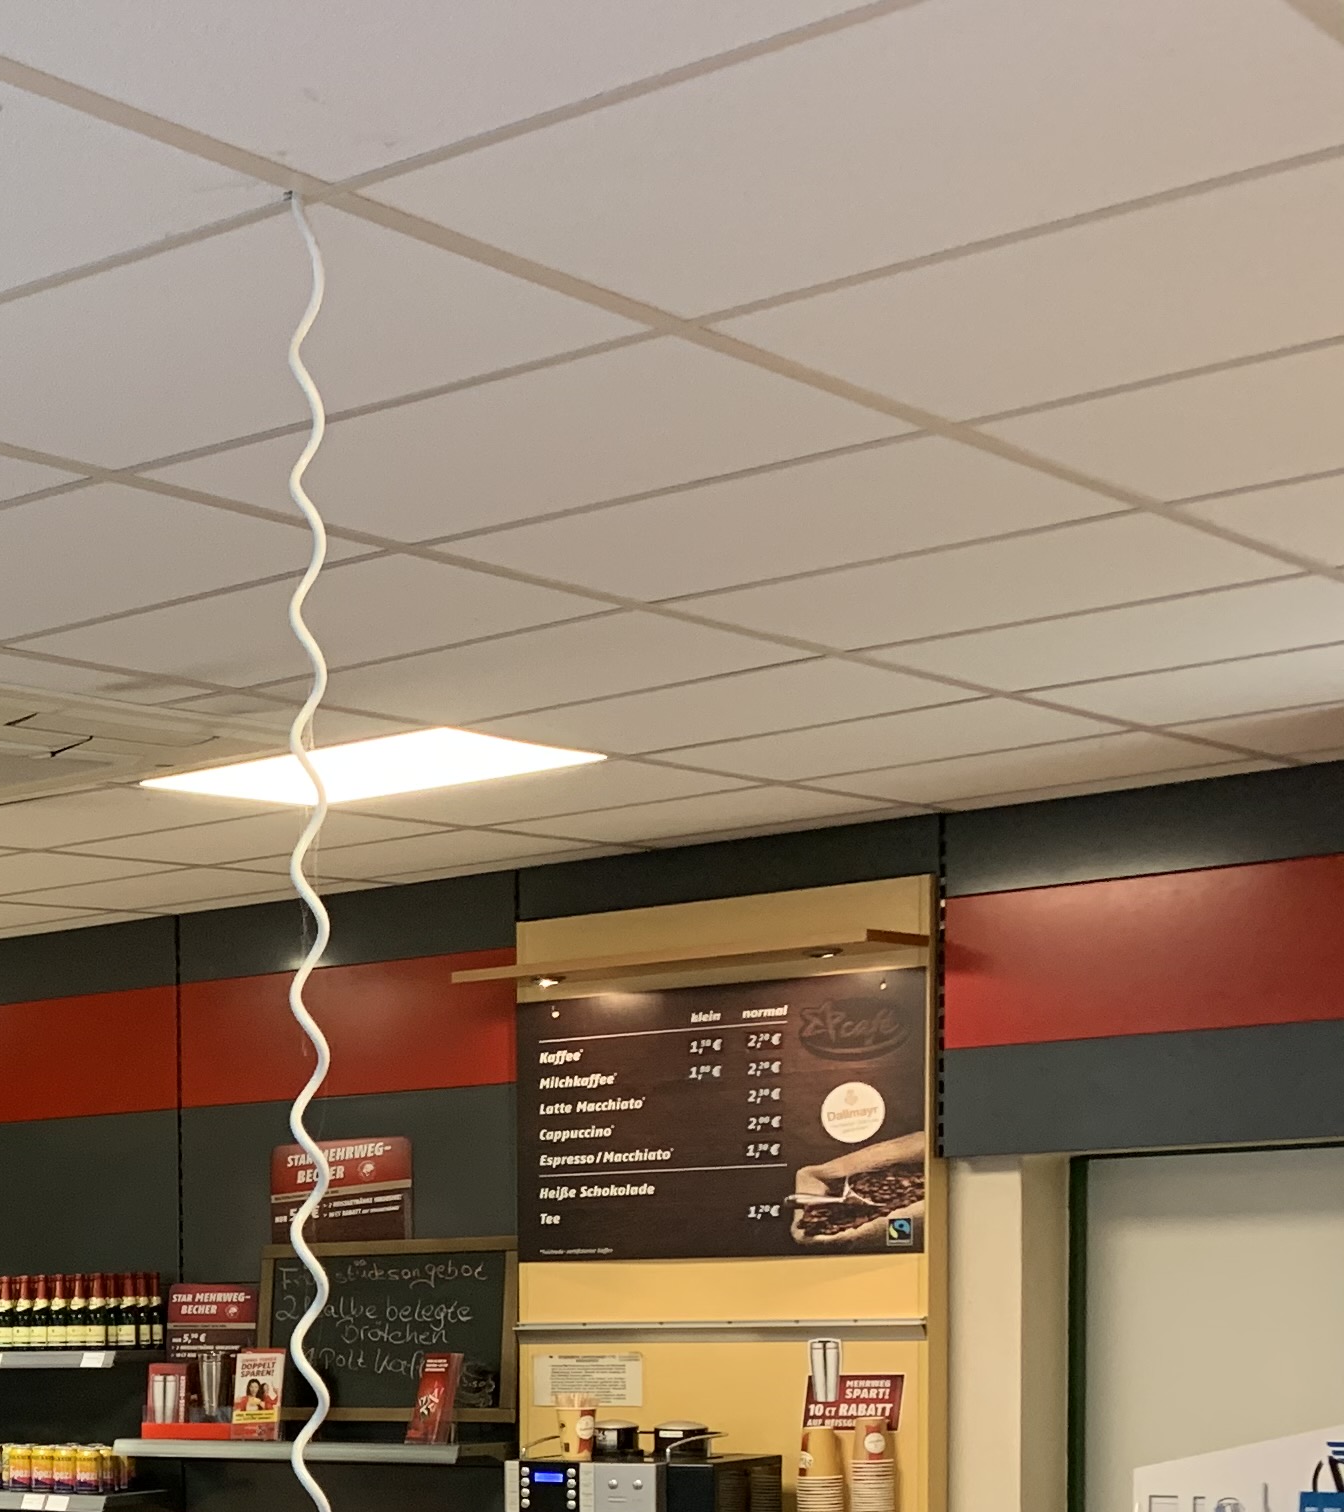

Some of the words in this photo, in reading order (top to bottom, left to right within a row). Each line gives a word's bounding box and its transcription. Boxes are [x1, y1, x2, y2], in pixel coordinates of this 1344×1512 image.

[690, 1010, 722, 1024] klein
[742, 1004, 789, 1019] normal
[539, 1101, 573, 1117] Latte
[826, 1104, 879, 1122] Dallmayr
[296, 1165, 345, 1184] BECER
[539, 1185, 577, 1200] Heiße
[580, 1183, 656, 1198] Schokolade
[539, 1213, 561, 1226] Tee
[181, 1305, 218, 1315] BECHER
[845, 1388, 890, 1400] SPART!
[838, 1403, 893, 1417] RABATT
